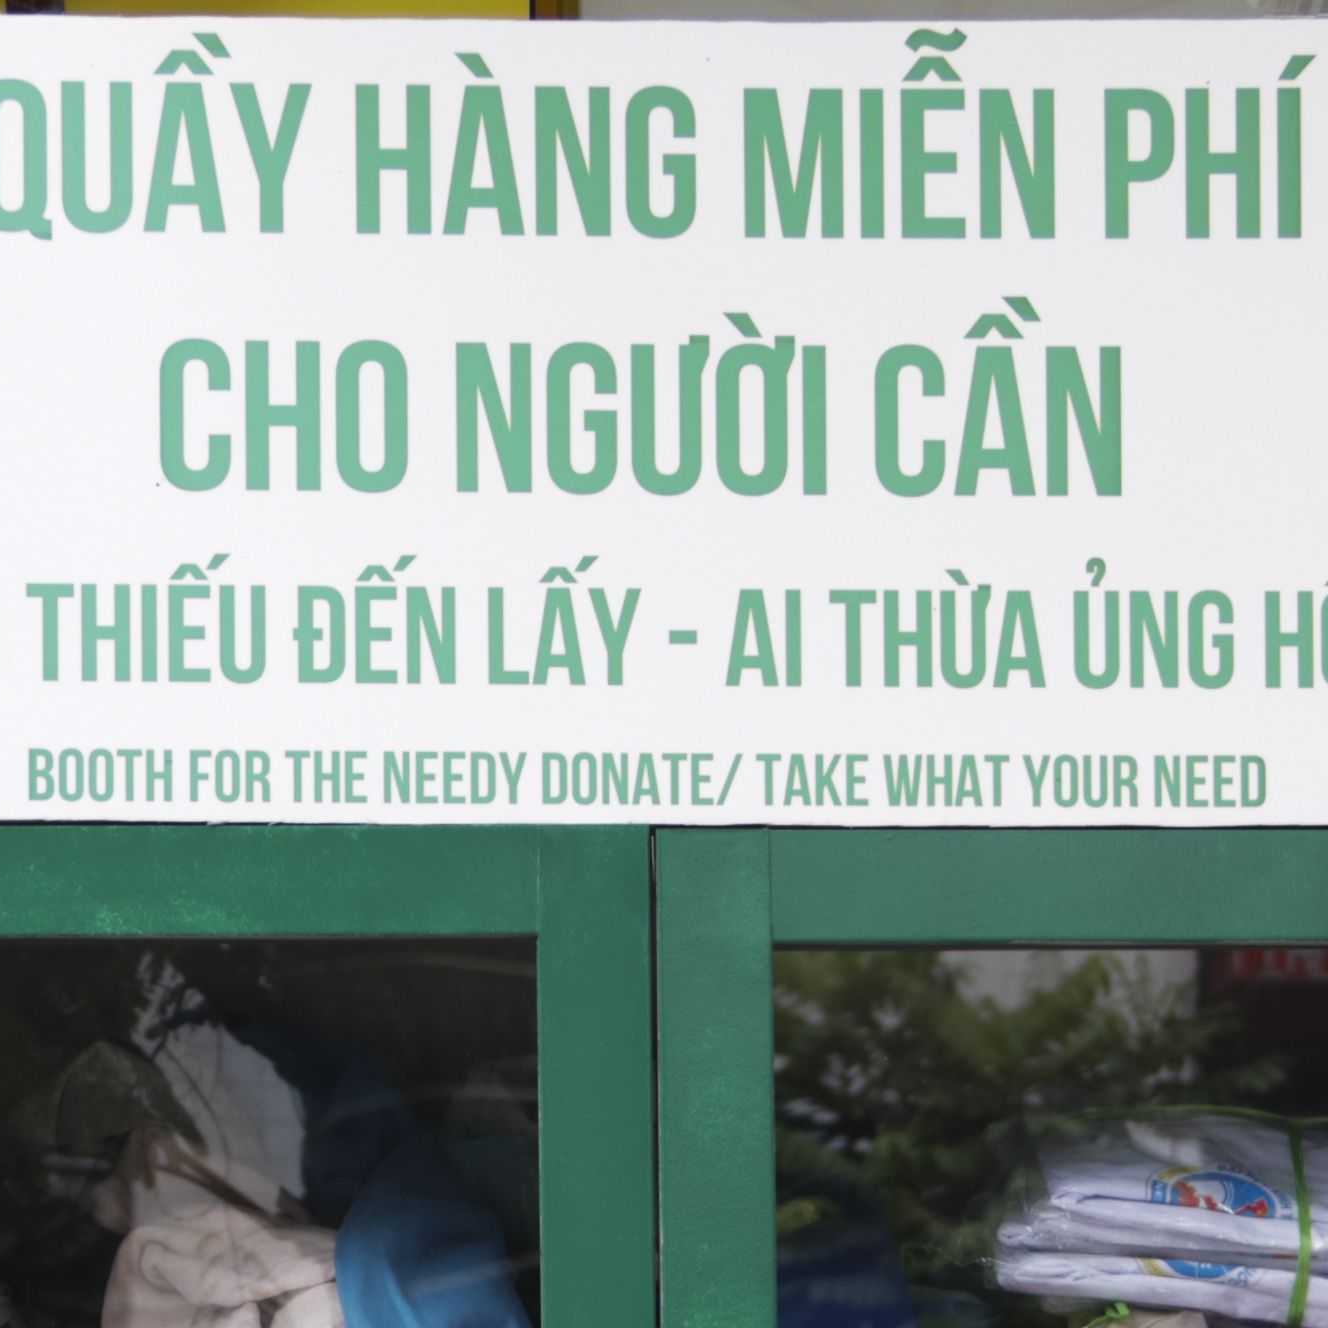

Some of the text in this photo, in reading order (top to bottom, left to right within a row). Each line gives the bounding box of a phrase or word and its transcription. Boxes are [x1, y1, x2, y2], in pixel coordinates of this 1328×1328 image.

[355, 52, 697, 239] HÀNG
[743, 28, 1057, 239] MIỄN
[1104, 55, 1317, 239] PHÍ
[159, 296, 1123, 498] CHO NGƯỜI CẦN
[26, 554, 267, 683] THIẾU
[292, 555, 457, 684] ĐẾN
[487, 556, 642, 686] LẤY
[725, 589, 803, 687] AI
[829, 569, 1046, 688] THỪA
[1073, 557, 1234, 690] ỦNG
[28, 748, 1267, 808] BOOTH FOR THE NEEDY DONATE/ TAKE WHAT YOUR NEED
